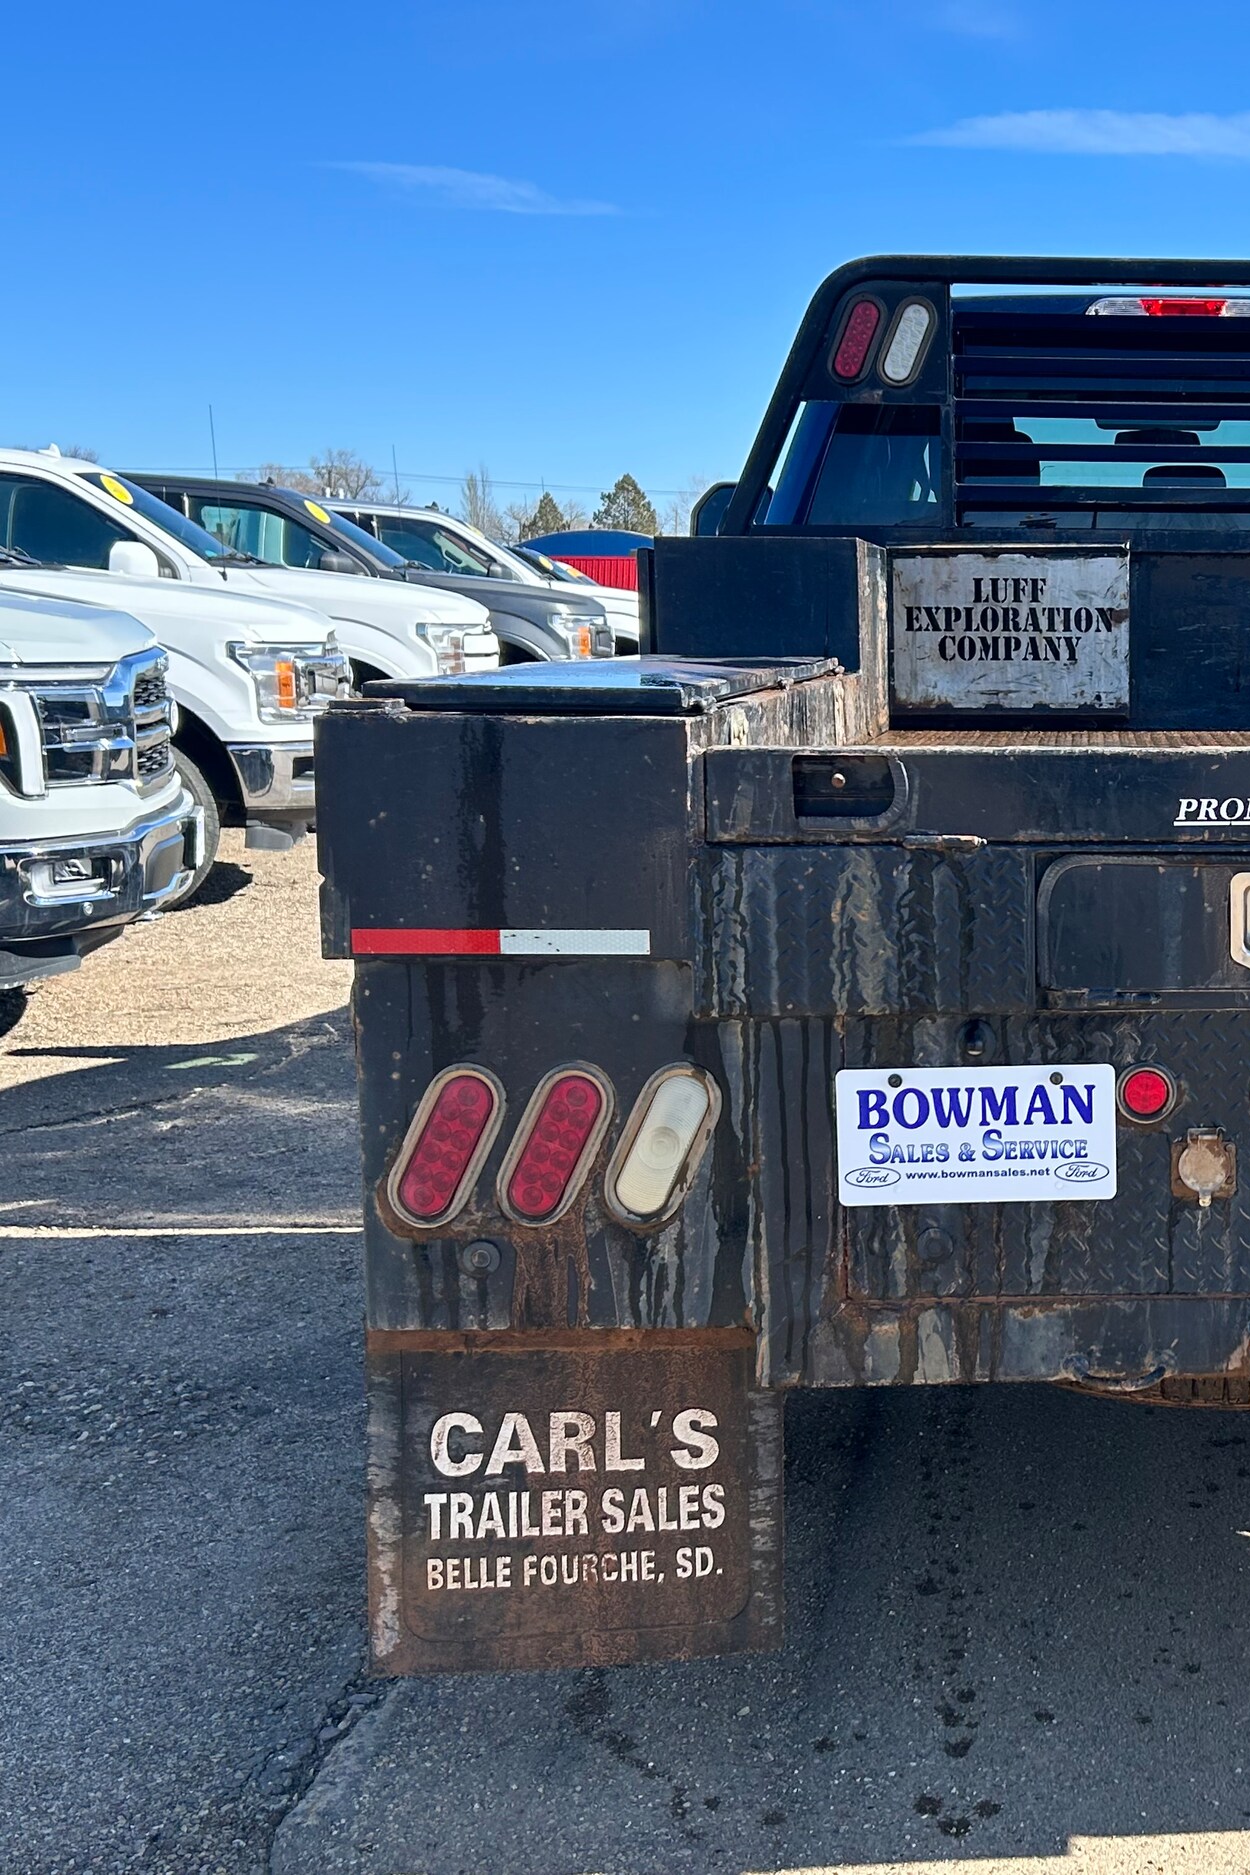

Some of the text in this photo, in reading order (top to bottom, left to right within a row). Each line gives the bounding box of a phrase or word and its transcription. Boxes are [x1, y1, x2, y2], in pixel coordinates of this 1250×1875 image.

[972, 577, 1047, 604] LUFF
[904, 606, 1115, 633] EXPLORATION
[938, 635, 1082, 662] COMPANY
[856, 1084, 1096, 1130] BOWMAN
[869, 1129, 1089, 1164] SALES & SERVICE
[853, 1168, 891, 1185] Ford
[905, 1167, 1050, 1180] www.bowmansales.net
[1062, 1162, 1100, 1180] Ford
[430, 1407, 720, 1478] CARL'S
[424, 1483, 726, 1541] TRAILER SALES
[426, 1545, 724, 1590] BELLE FOURCHE, SD.
